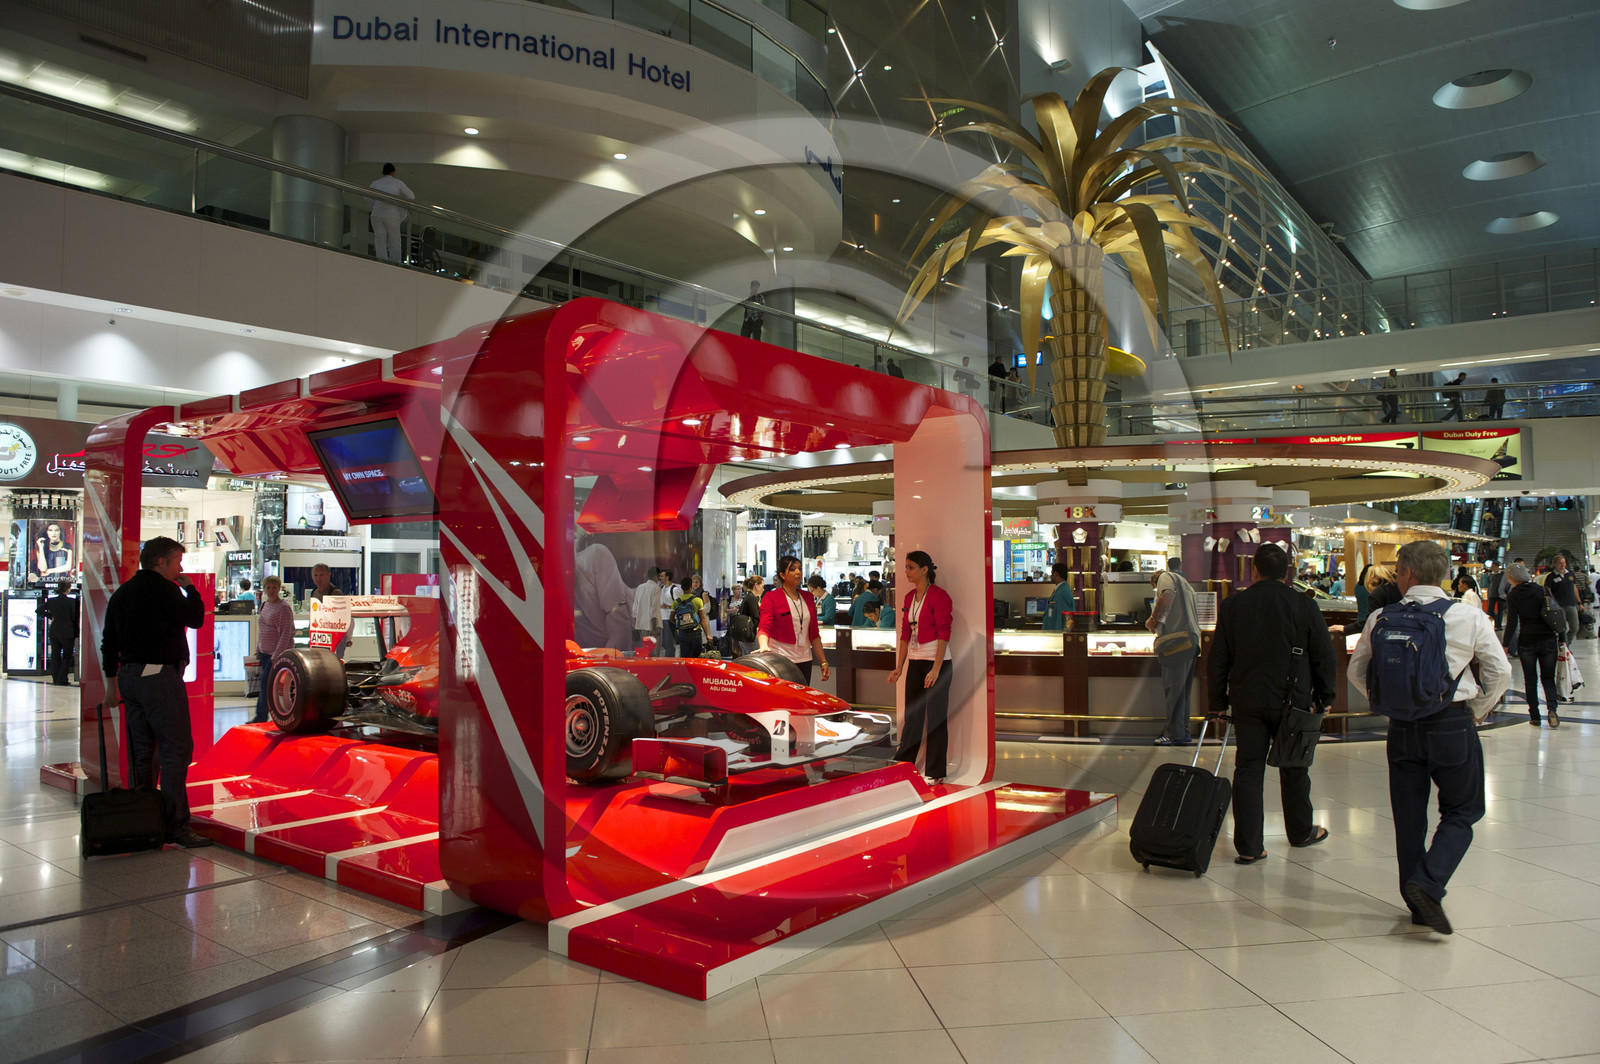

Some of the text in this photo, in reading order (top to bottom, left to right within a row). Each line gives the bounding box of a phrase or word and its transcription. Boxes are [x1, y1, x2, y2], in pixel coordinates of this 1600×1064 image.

[332, 16, 691, 93] Dubai International Hotel
[20, 453, 32, 469] FREE
[351, 471, 366, 480] OWN
[365, 469, 384, 478] SPACE
[1064, 506, 1096, 519] 18K
[228, 552, 252, 561] GIVENC
[319, 618, 347, 630] Santander
[311, 633, 327, 643] AMD
[702, 677, 743, 688] MUBADALA
[592, 688, 610, 756] POTENZA
